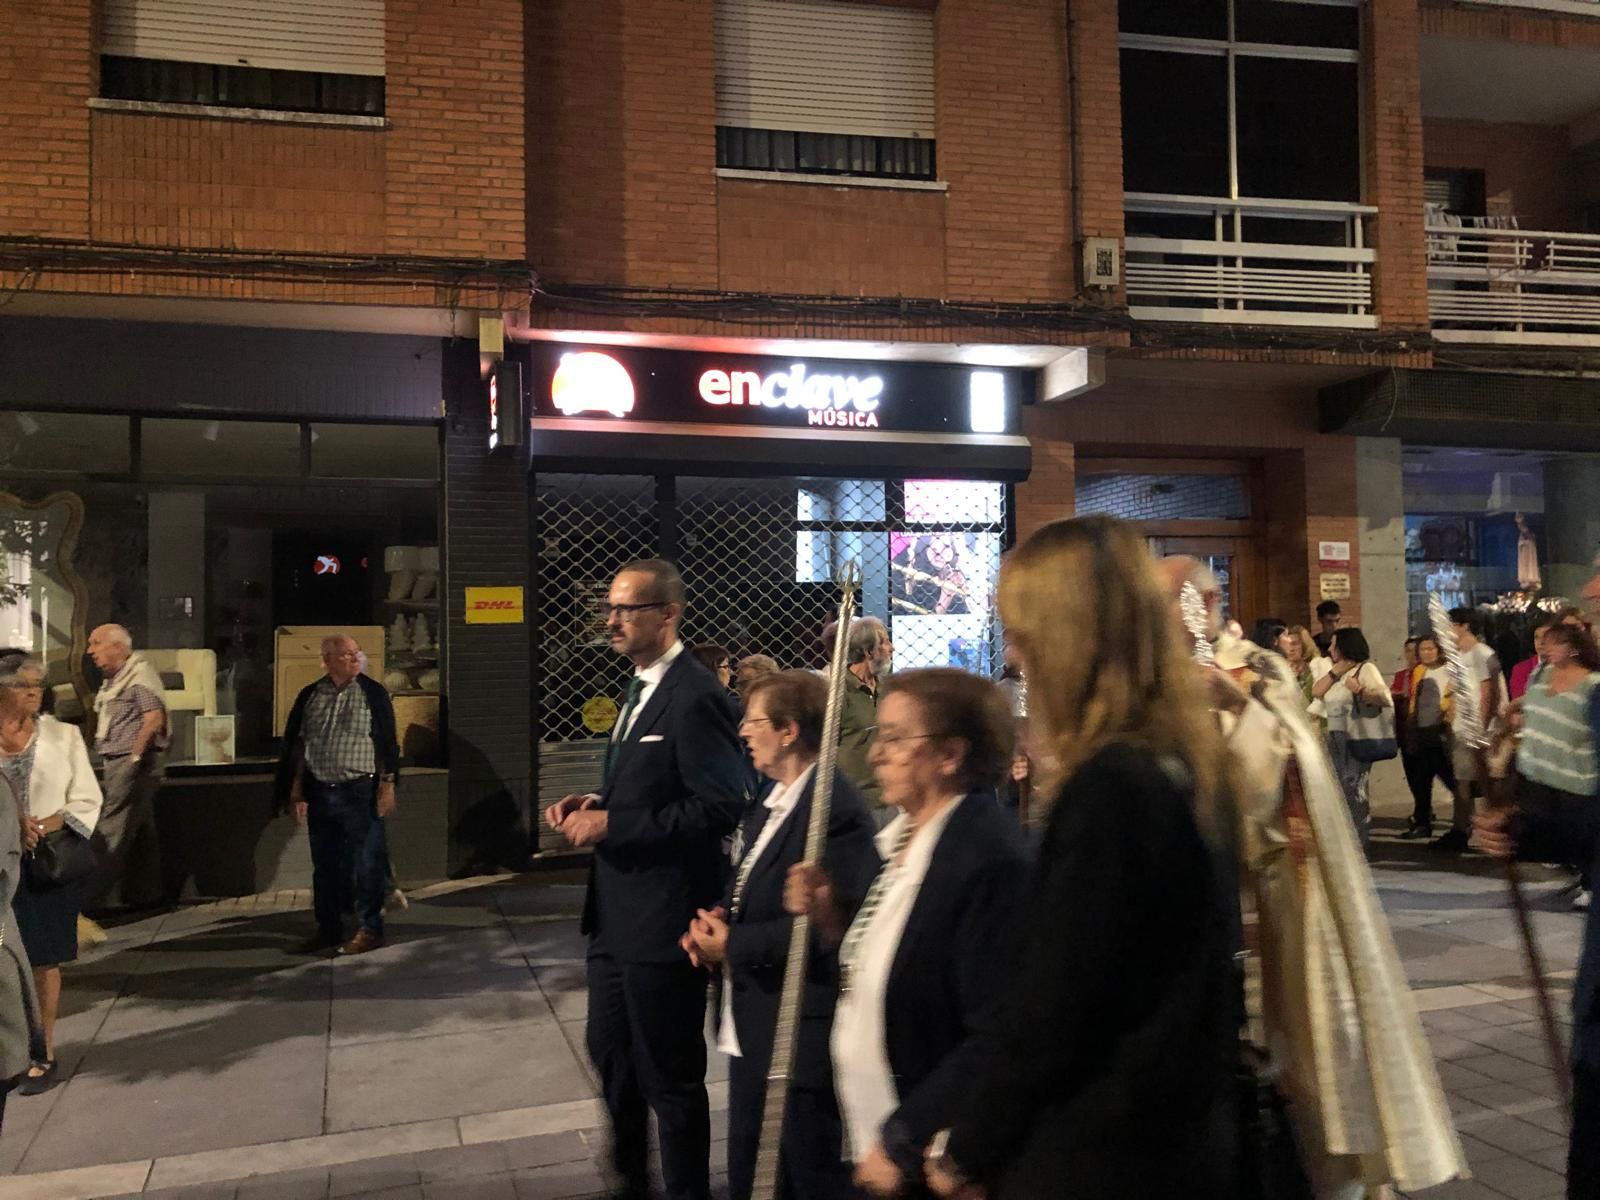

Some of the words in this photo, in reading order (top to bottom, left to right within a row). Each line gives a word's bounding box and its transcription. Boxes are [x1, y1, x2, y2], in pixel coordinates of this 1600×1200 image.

[698, 363, 884, 411] enclave
[807, 408, 879, 428] MÚSICA
[474, 600, 514, 610] DHL
